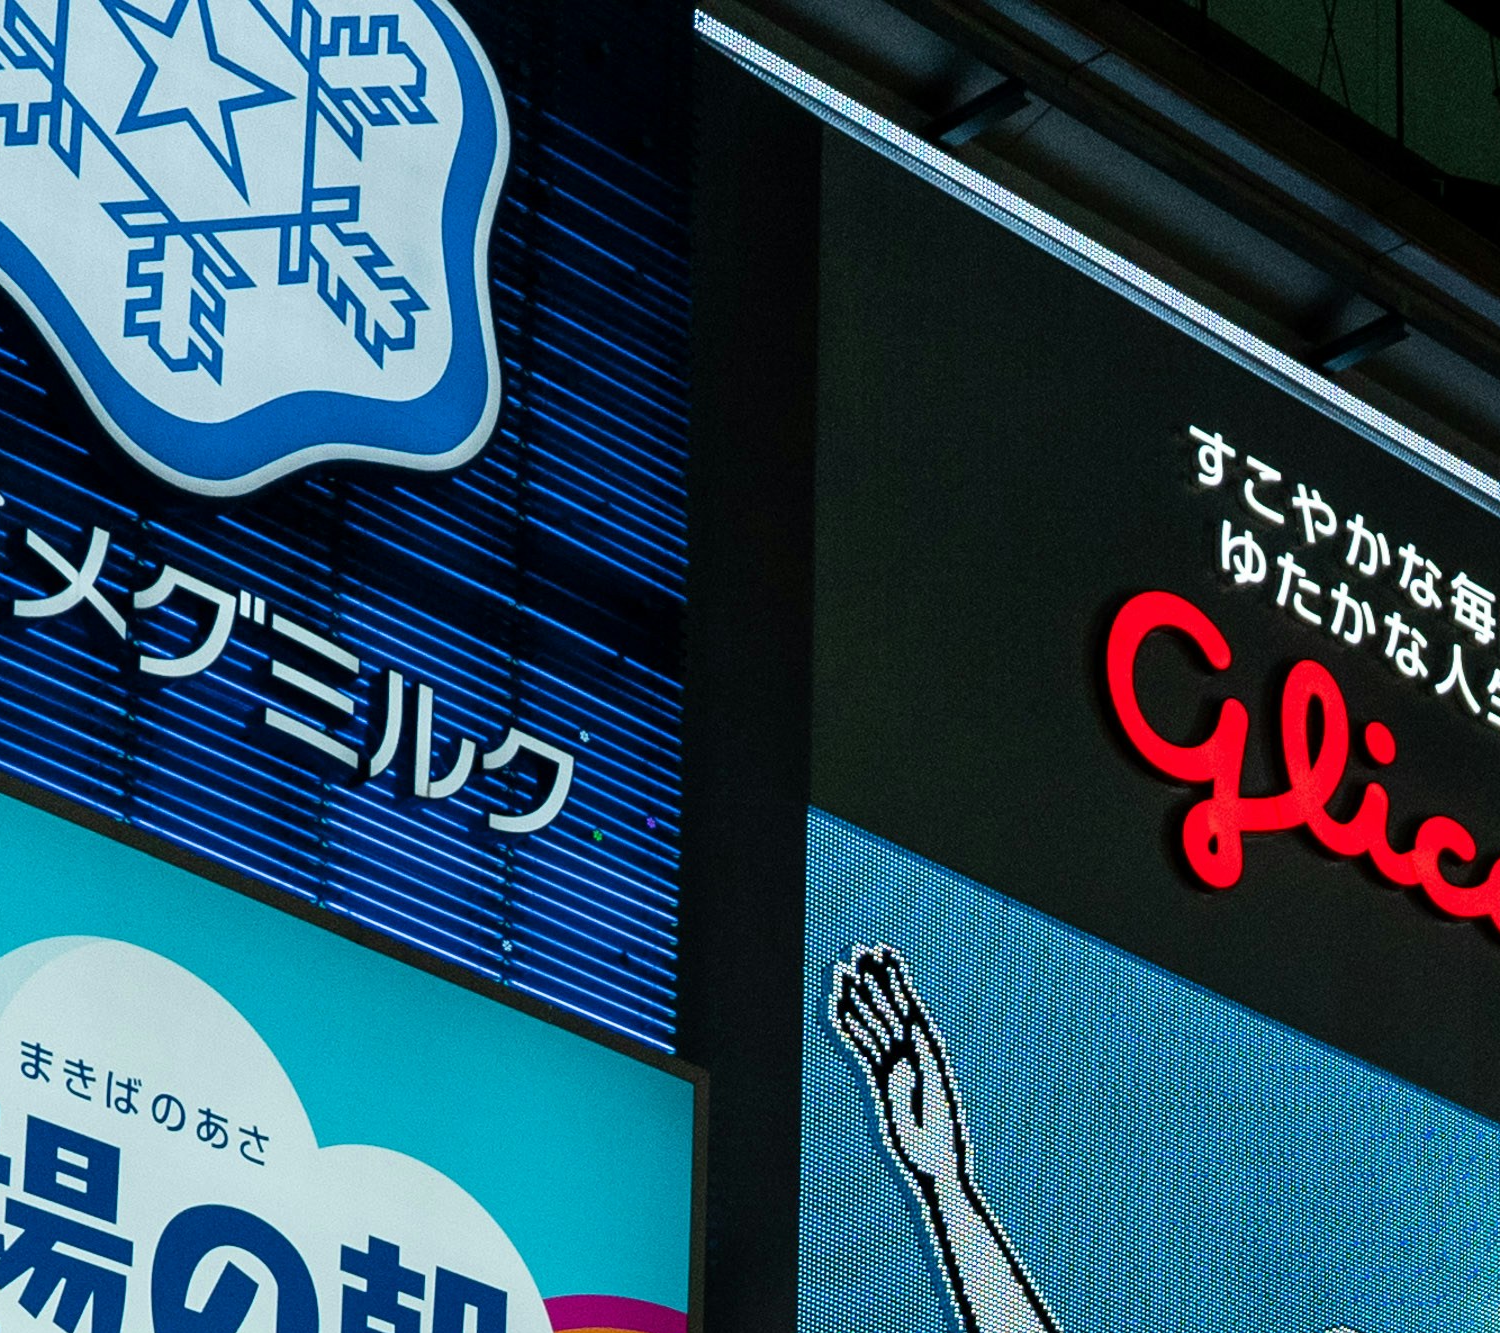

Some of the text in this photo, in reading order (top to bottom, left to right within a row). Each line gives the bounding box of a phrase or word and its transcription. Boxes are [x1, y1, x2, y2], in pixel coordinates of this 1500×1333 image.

[20, 1041, 272, 1167] まきばのあさ
